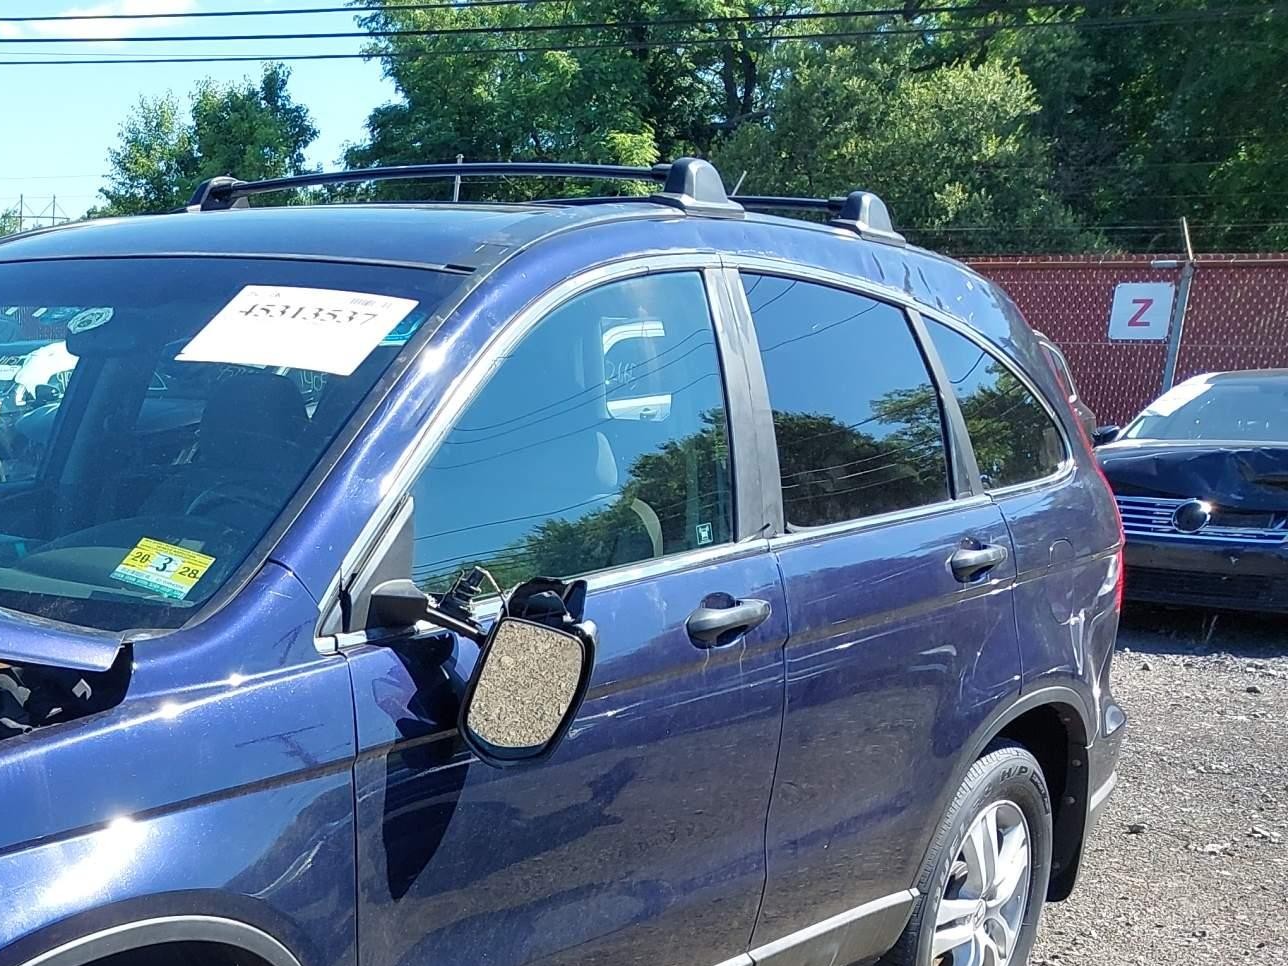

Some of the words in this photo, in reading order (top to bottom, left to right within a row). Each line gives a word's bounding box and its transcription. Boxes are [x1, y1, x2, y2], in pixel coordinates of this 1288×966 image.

[240, 303, 379, 326] 45313537
[1128, 298, 1153, 326] Z
[132, 551, 150, 564] 20
[155, 556, 173, 572] 3
[178, 566, 200, 579] 28
